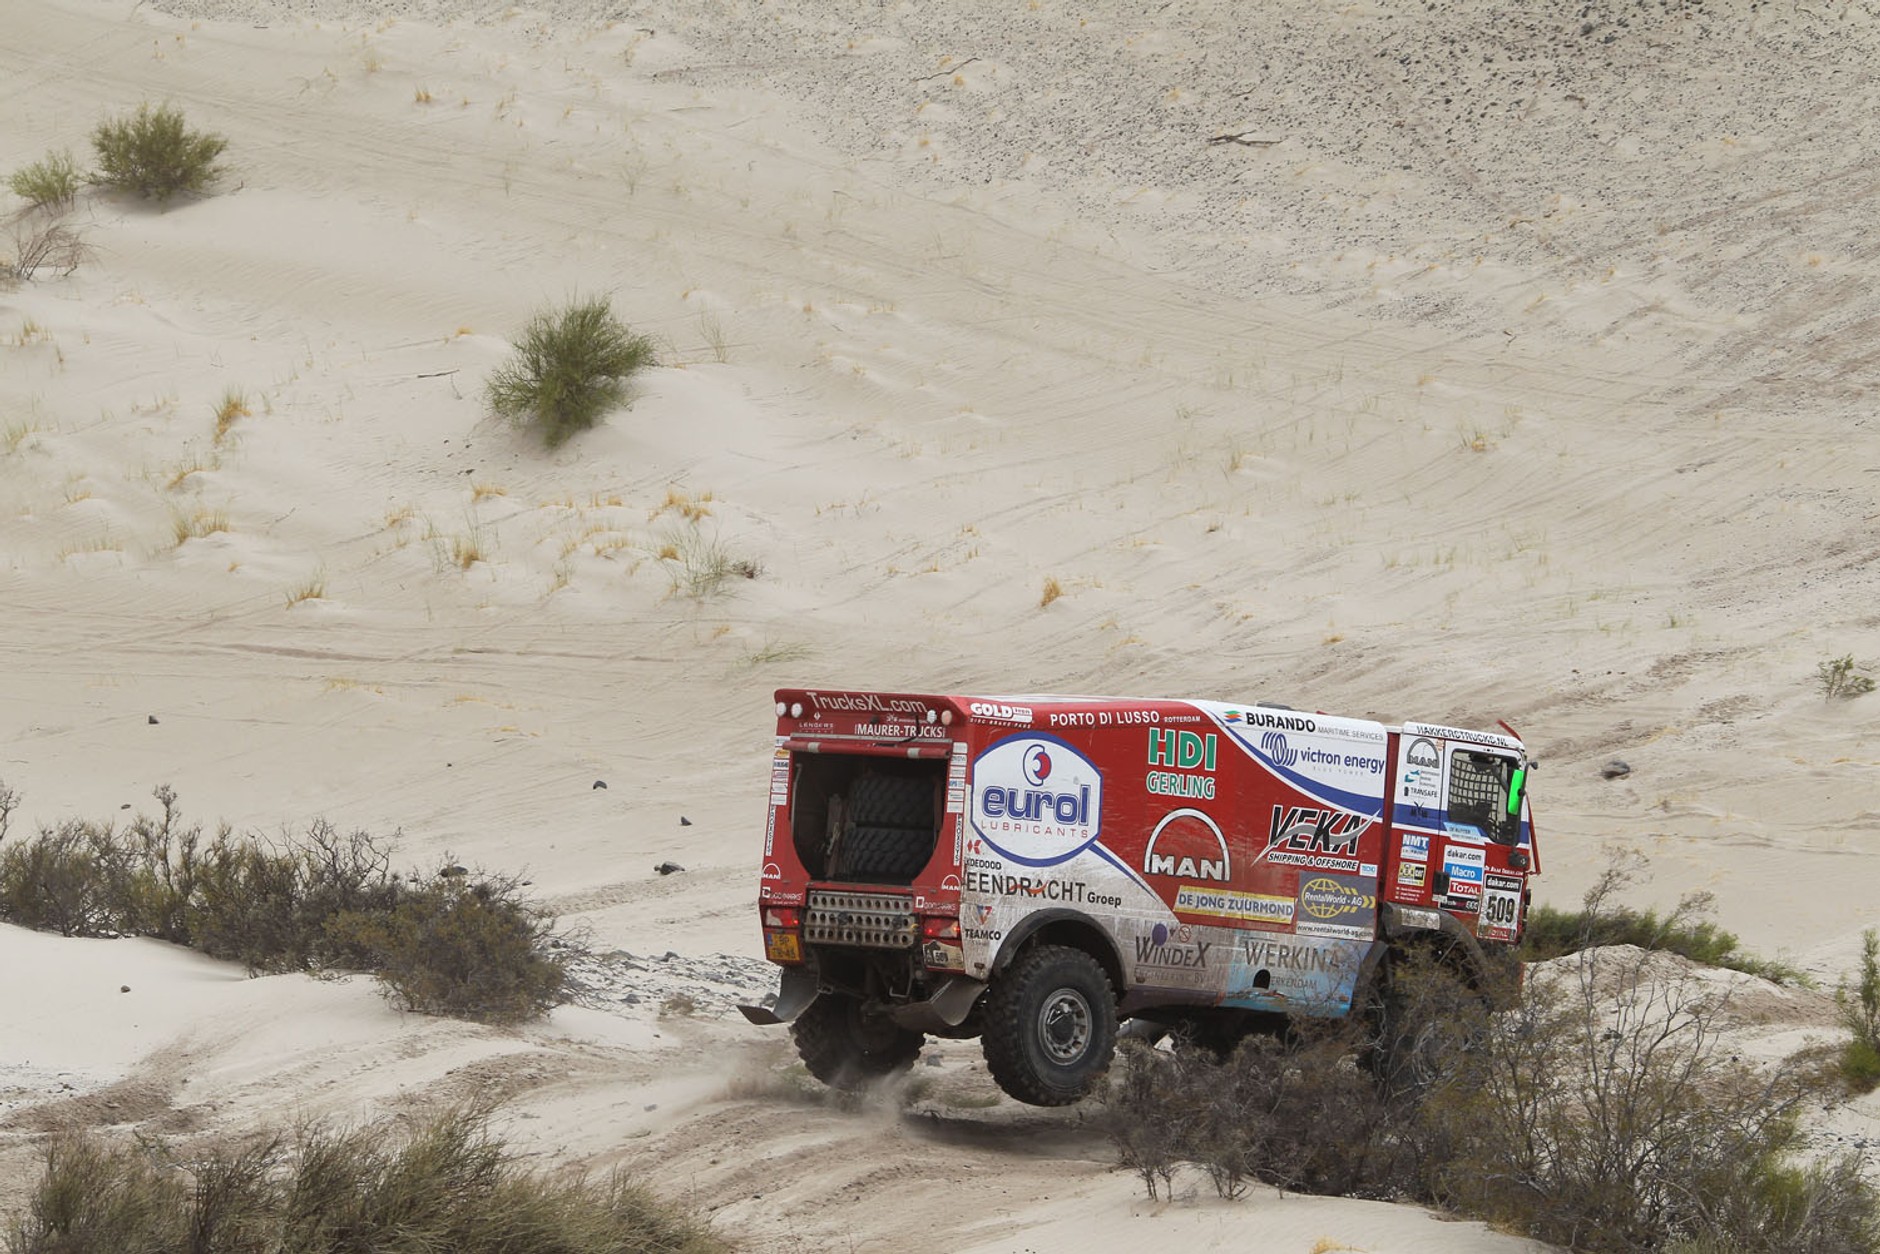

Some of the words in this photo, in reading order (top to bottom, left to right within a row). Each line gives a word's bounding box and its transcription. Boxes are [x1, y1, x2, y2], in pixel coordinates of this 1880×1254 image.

[806, 691, 928, 714] TrucksXL.com
[970, 703, 1013, 718] GOLD
[1050, 712, 1095, 726] PORTO
[1099, 712, 1112, 725] DI
[1117, 710, 1160, 724] LUSSO
[1163, 715, 1201, 723] ROTTERDAM
[1246, 712, 1316, 733] BURANDO
[1318, 726, 1349, 737] MARITIME
[1350, 730, 1384, 741] SERVICES
[857, 723, 943, 738] MAURER-TRUCKS
[1148, 727, 1218, 772] HDI
[1300, 747, 1341, 766] victron
[1344, 755, 1385, 775] energy
[1146, 770, 1216, 800] GERLING
[982, 784, 1091, 826] eurol
[981, 821, 1089, 839] LUBRICANTS
[1268, 804, 1364, 856] VEKA
[1268, 852, 1307, 866] SHIPPING
[1314, 857, 1359, 871] OFFSHORE
[1447, 849, 1482, 861] dakar.com
[1150, 854, 1224, 881] MAN
[1451, 866, 1475, 878] Macro
[966, 871, 1086, 903] EENDRACHT
[1087, 892, 1122, 909] Groep
[1451, 882, 1480, 895] TOTAL
[1486, 877, 1520, 889] dakar.com
[1179, 893, 1192, 906] DE
[1194, 895, 1226, 909] JONG
[1227, 896, 1294, 916] ZUURMOND
[1486, 895, 1515, 923] 509
[965, 928, 1002, 941] TEAMCO
[1270, 975, 1318, 990] ERKENDAM
